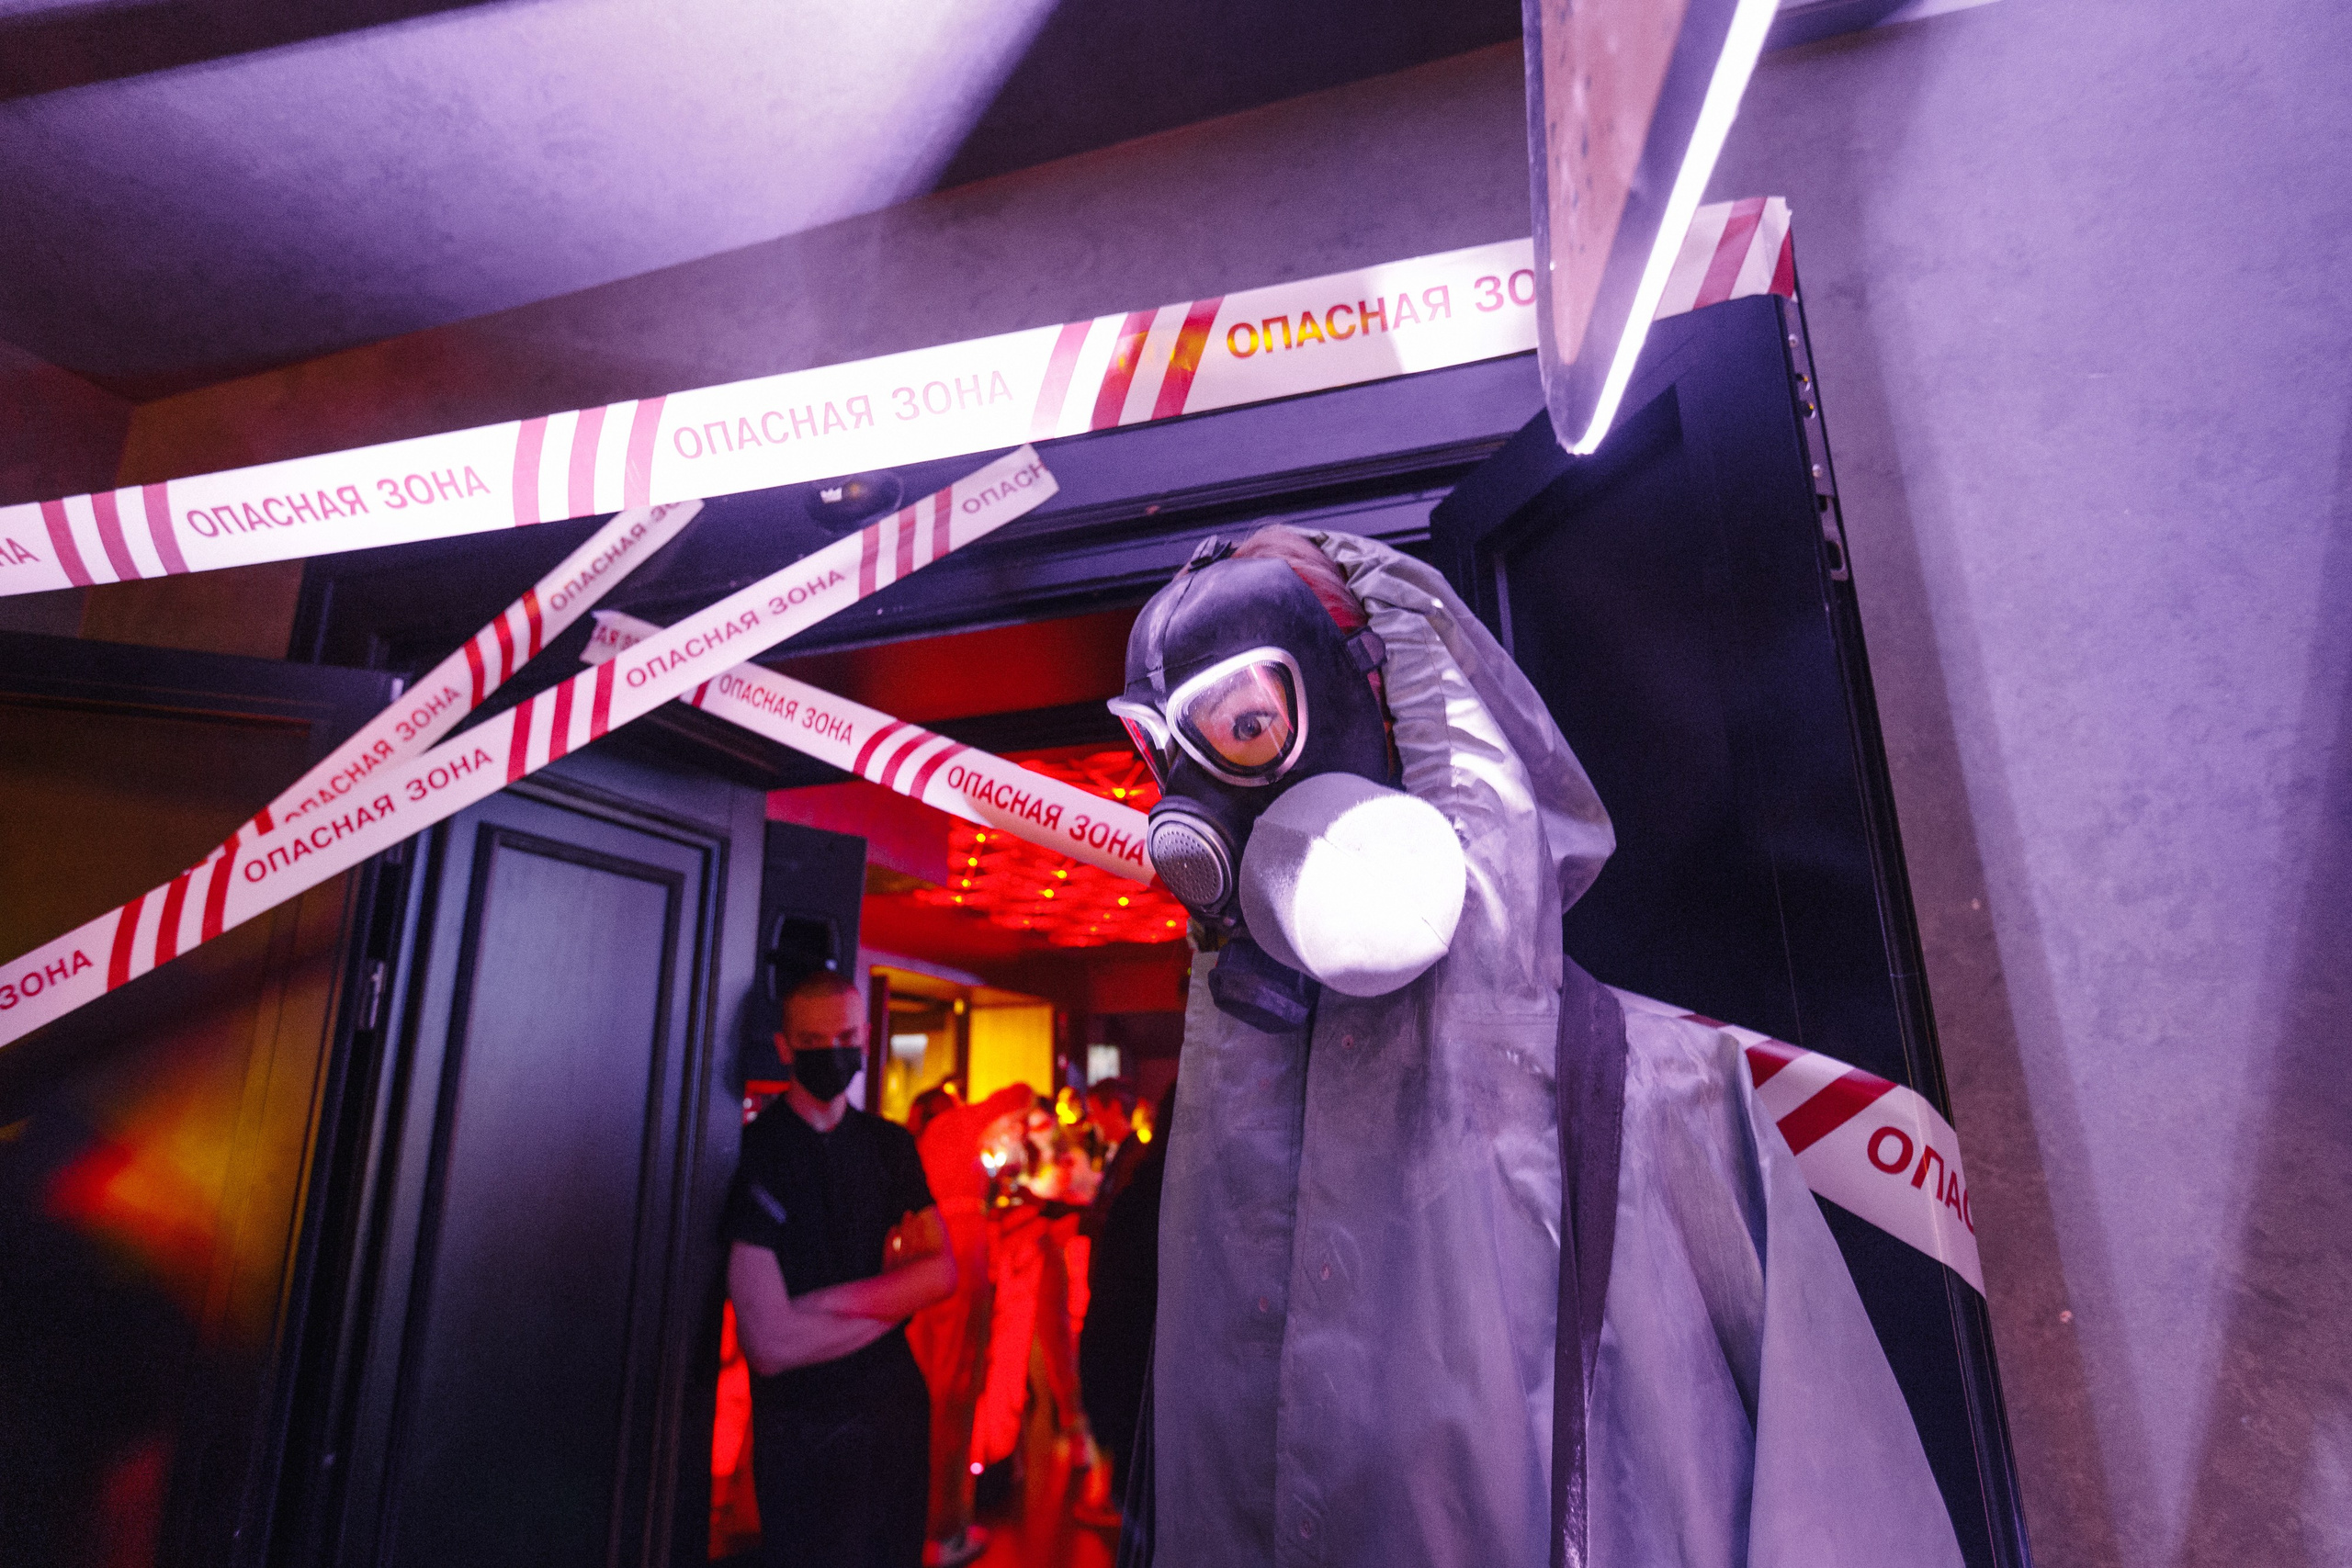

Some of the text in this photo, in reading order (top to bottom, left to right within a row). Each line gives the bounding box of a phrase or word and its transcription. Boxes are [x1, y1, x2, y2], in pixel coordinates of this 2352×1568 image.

[1226, 286, 1452, 361] ОПАСНАЯ
[673, 370, 1013, 460] ОПАСНАЯ ЗОНА
[186, 466, 491, 538] ОПАСНАЯ ЗОНА
[549, 523, 648, 612] ОПАСНАЯ
[626, 570, 846, 688] ОПАСНАЯ ЗОНА
[395, 686, 461, 741] ЗОНА
[718, 673, 854, 745] ОПАСНАЯ ЗОНА
[244, 748, 492, 883] ОПАСНАЯ ЗОНА
[947, 766, 1148, 866] ОПАСНАЯ ЗОНА
[0, 950, 93, 1010] ЗОНА
